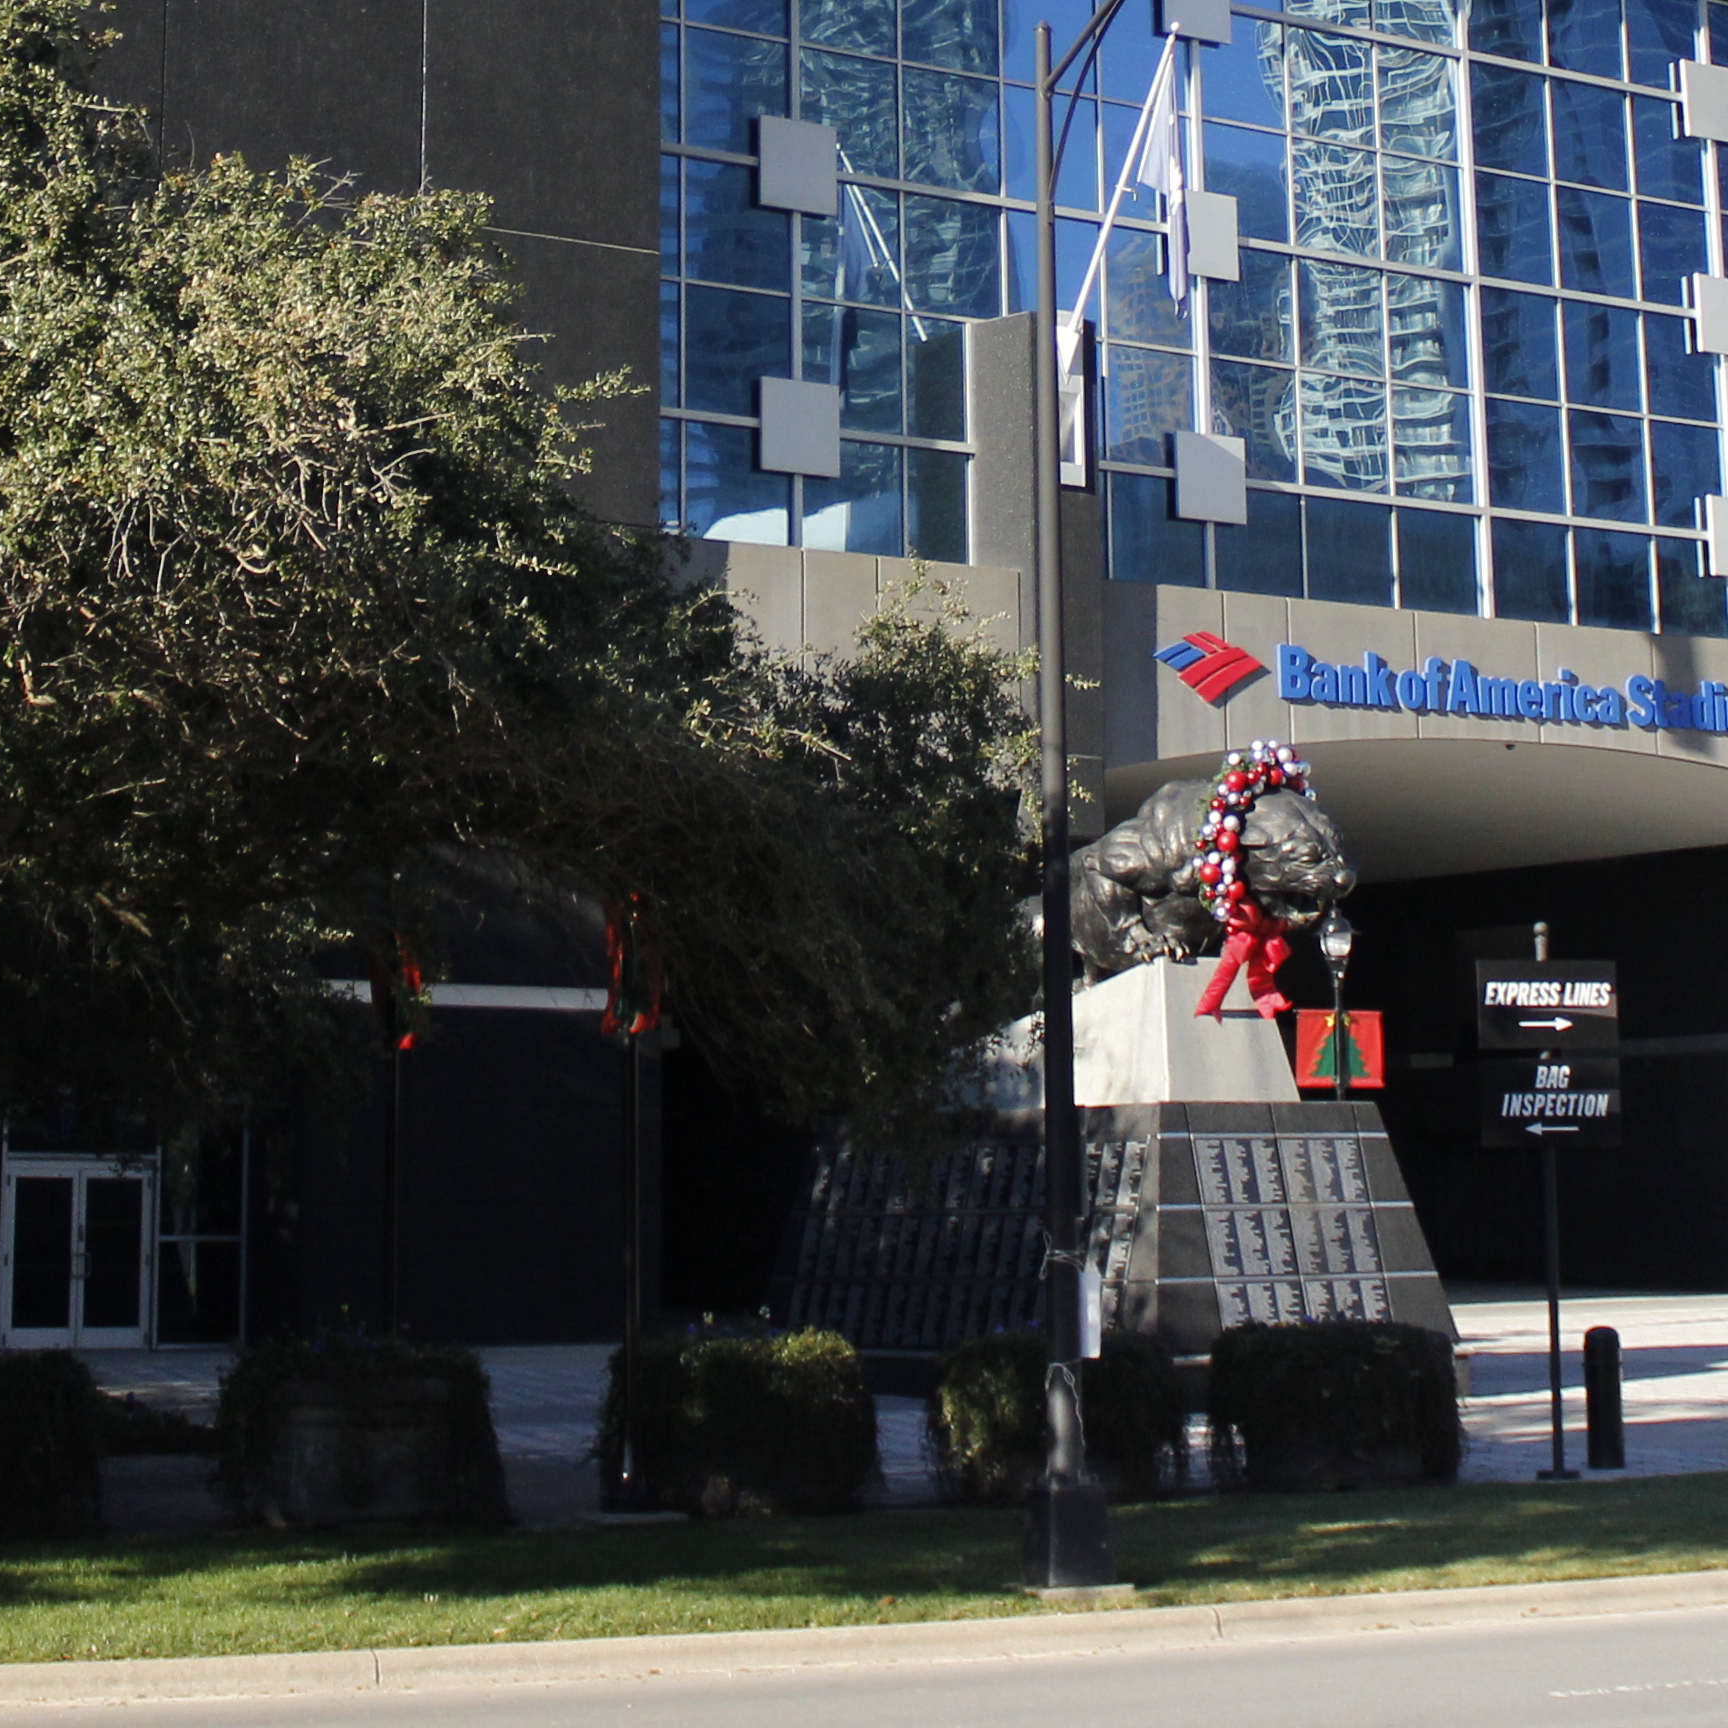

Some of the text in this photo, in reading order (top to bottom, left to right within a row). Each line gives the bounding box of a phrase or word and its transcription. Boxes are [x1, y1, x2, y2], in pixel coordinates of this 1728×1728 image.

[1277, 643, 1398, 708] Bank
[1398, 656, 1443, 711] of
[1447, 658, 1621, 725] America
[1485, 982, 1612, 1007] EXPRESS LINES
[1535, 1065, 1571, 1089] BAG
[1501, 1094, 1609, 1117] INSPECTION
